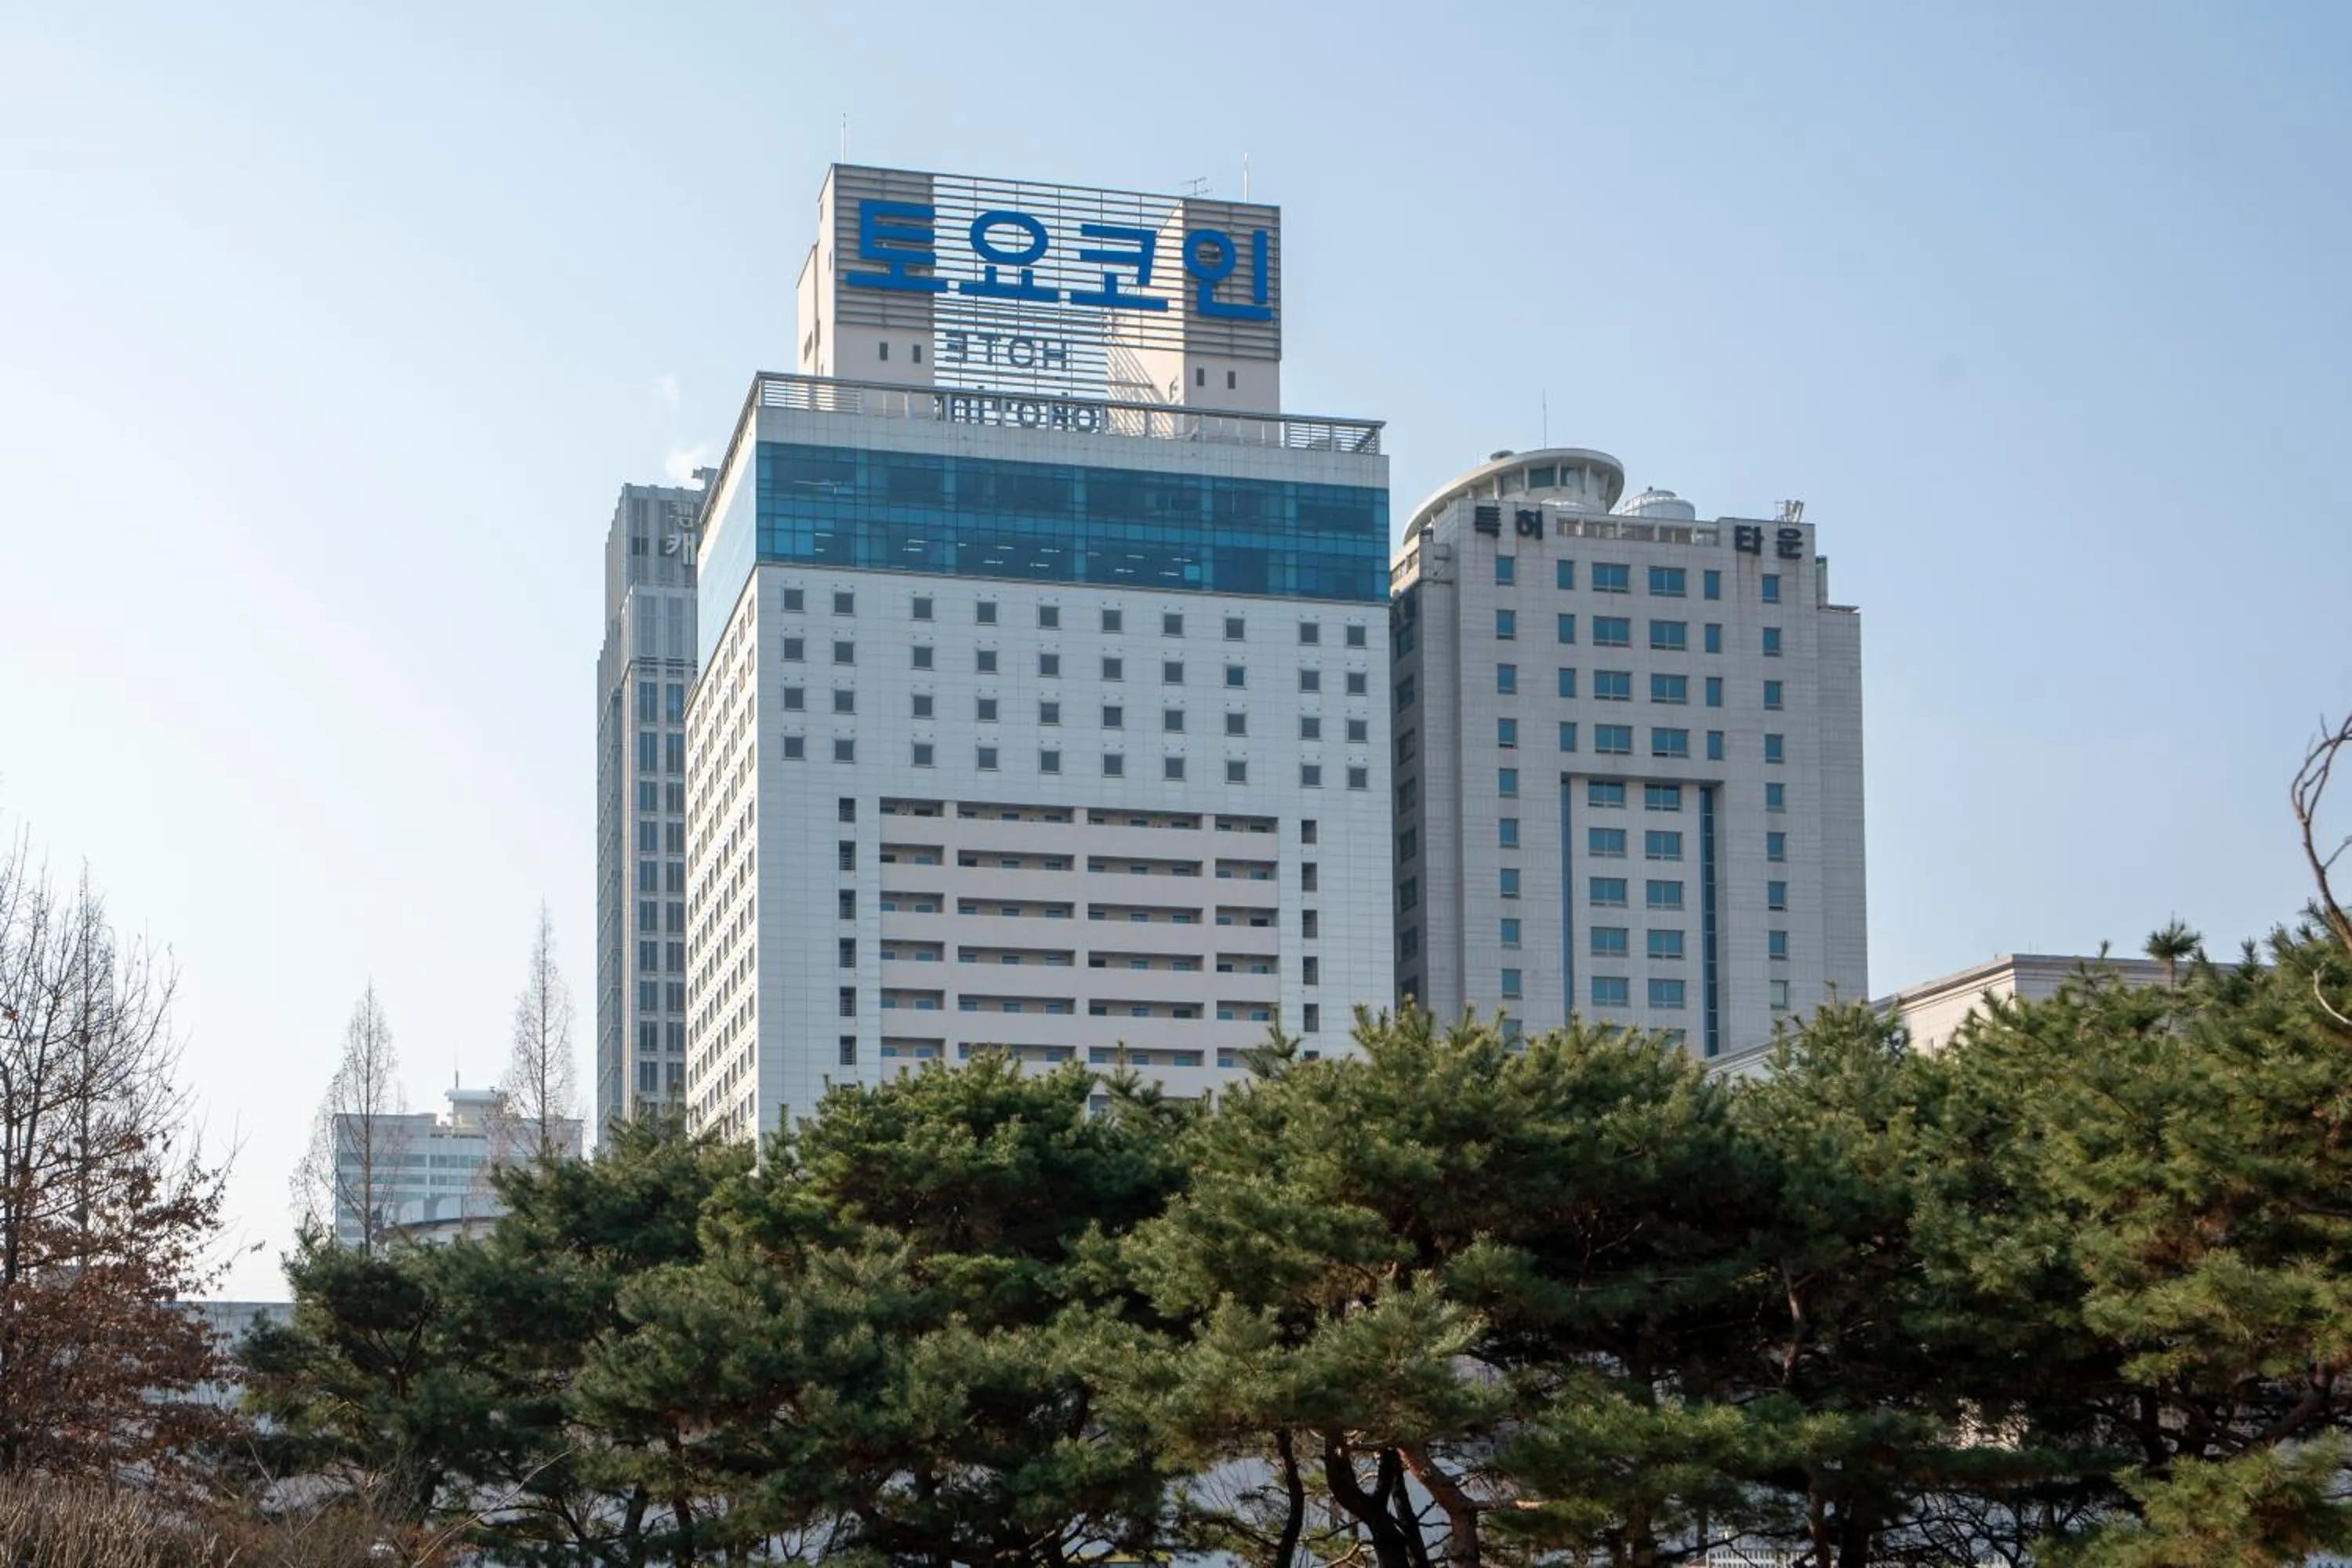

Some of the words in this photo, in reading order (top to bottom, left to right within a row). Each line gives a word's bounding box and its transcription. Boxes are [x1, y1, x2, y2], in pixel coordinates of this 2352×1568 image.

[846, 198, 1273, 322] 토요코인
[1474, 506, 1544, 540] 특허
[1734, 524, 1804, 559] 타운
